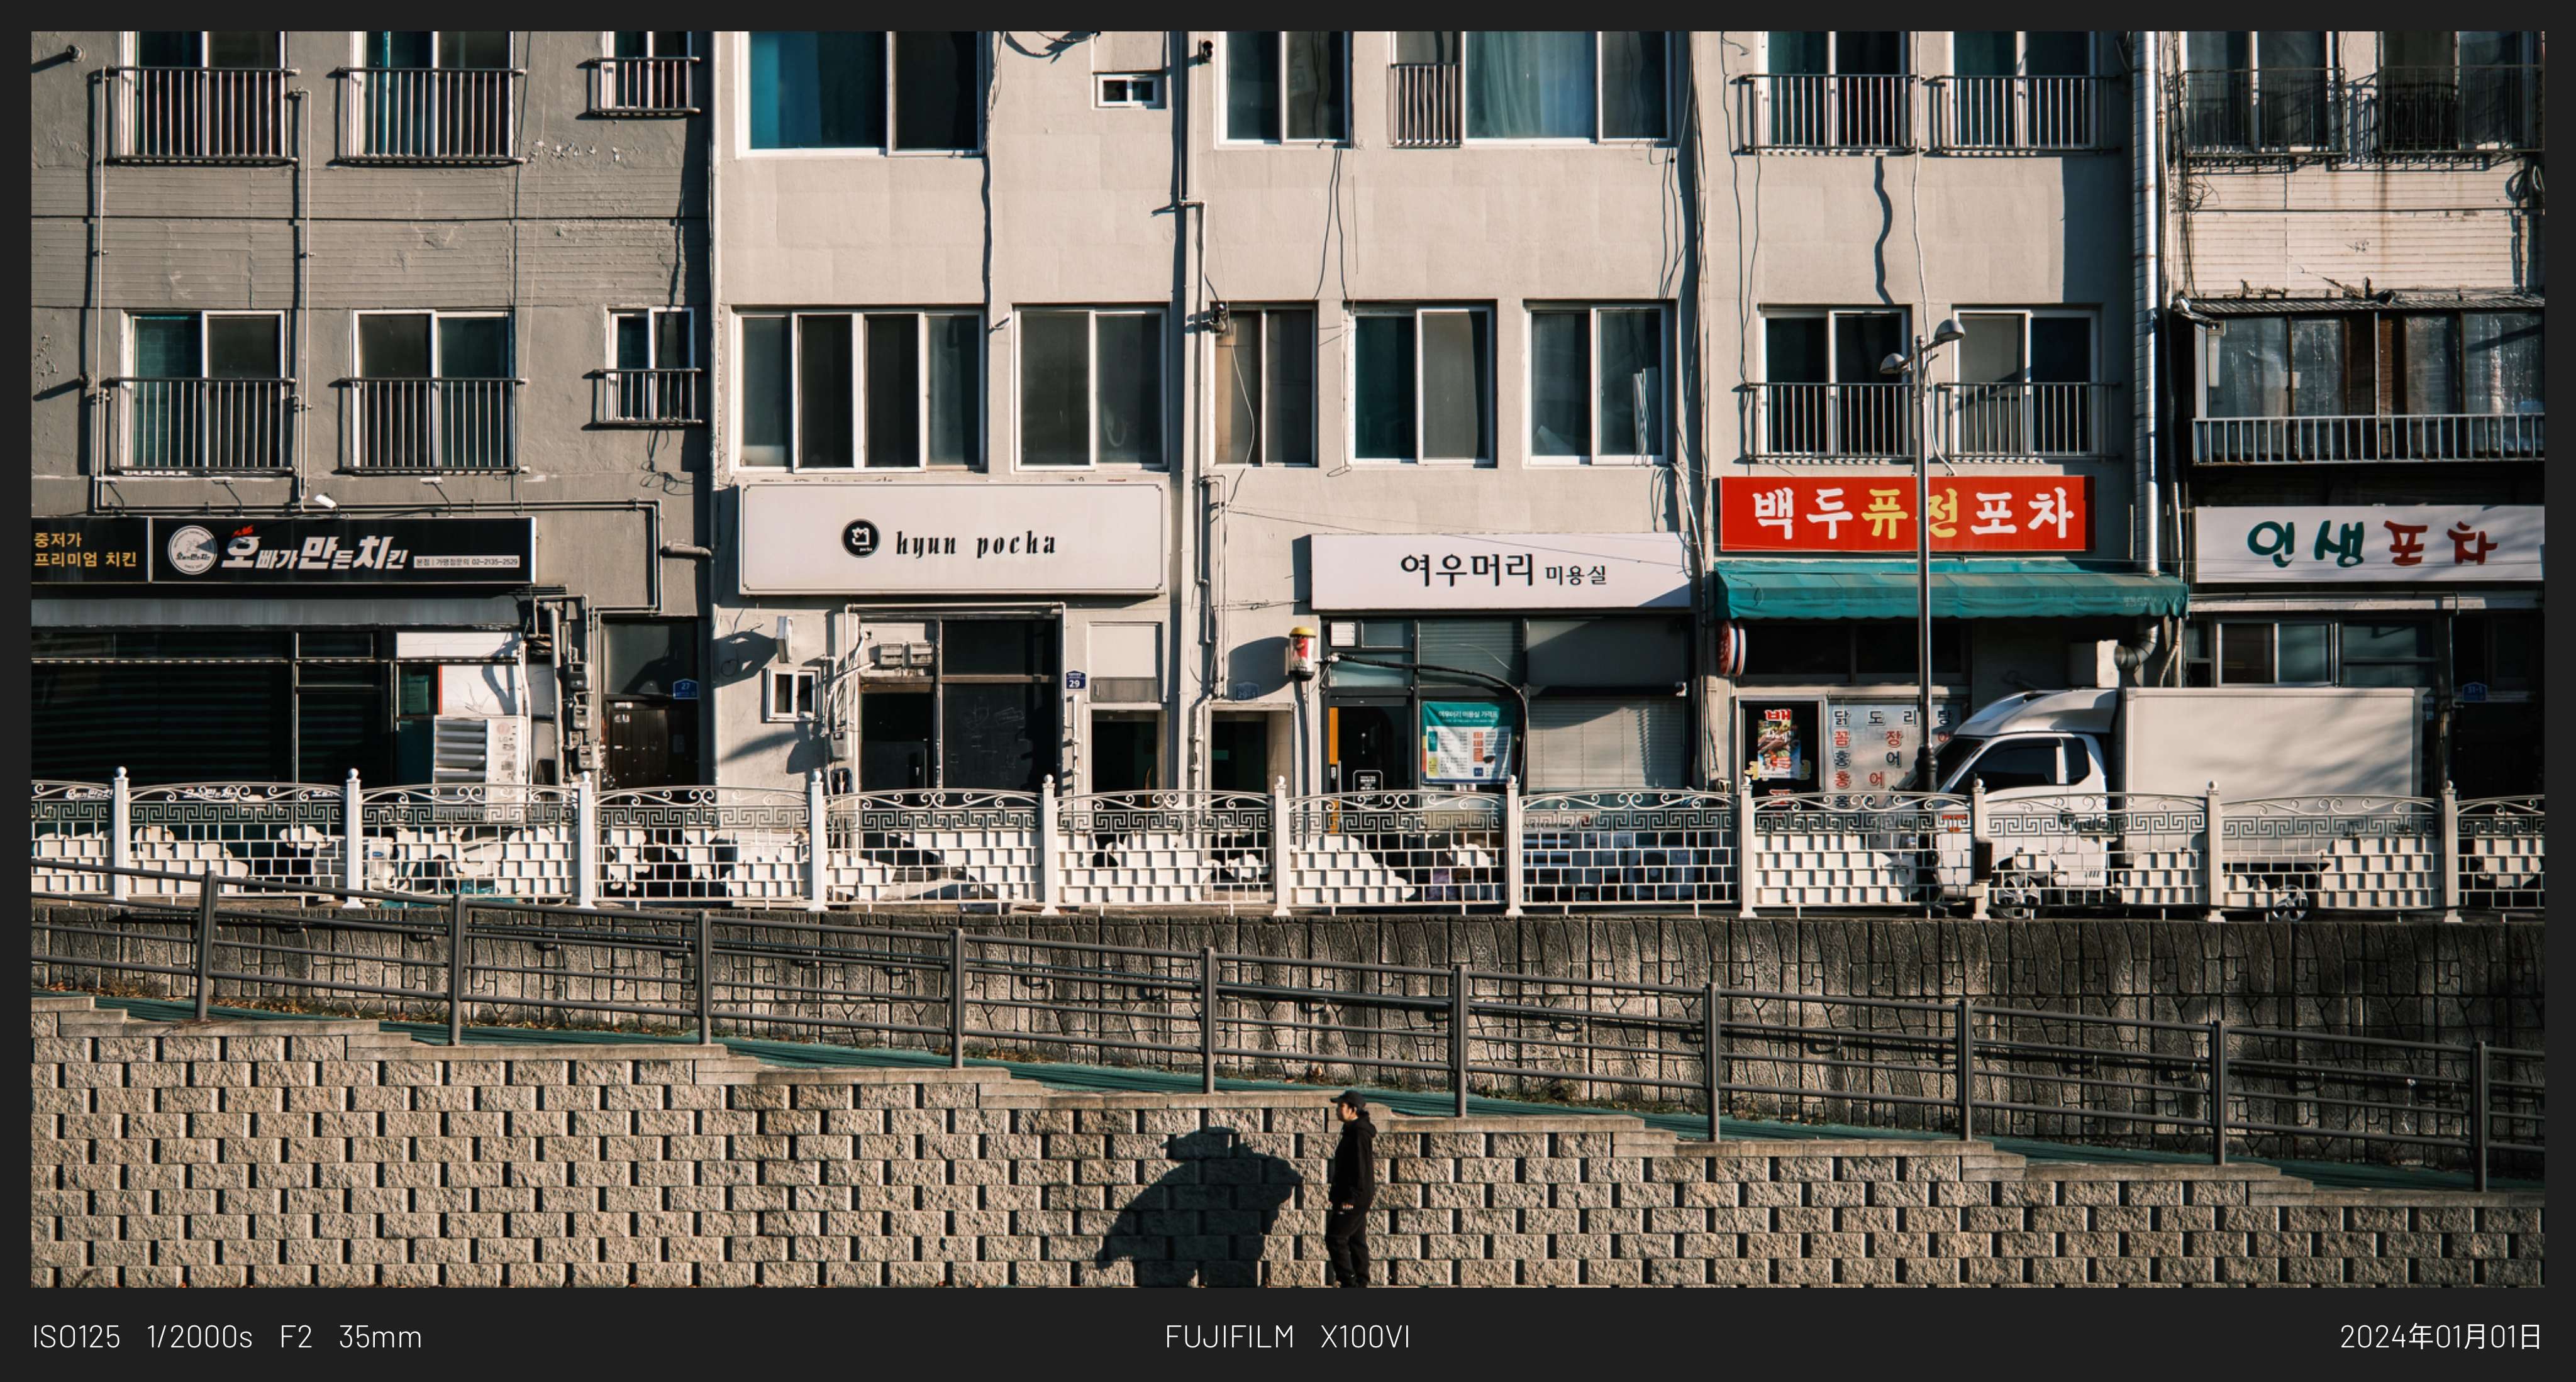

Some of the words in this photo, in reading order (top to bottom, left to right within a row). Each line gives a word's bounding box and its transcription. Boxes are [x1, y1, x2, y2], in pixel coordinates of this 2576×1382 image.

[34, 532, 82, 548] 중저가
[896, 530, 956, 559] hyun
[977, 530, 1055, 559] pocha
[34, 551, 97, 567] 프리미엄
[106, 551, 136, 567] 치킨
[1401, 553, 1533, 587] 여우머리
[1545, 565, 1606, 586] 미용실
[1069, 680, 1080, 688] 29
